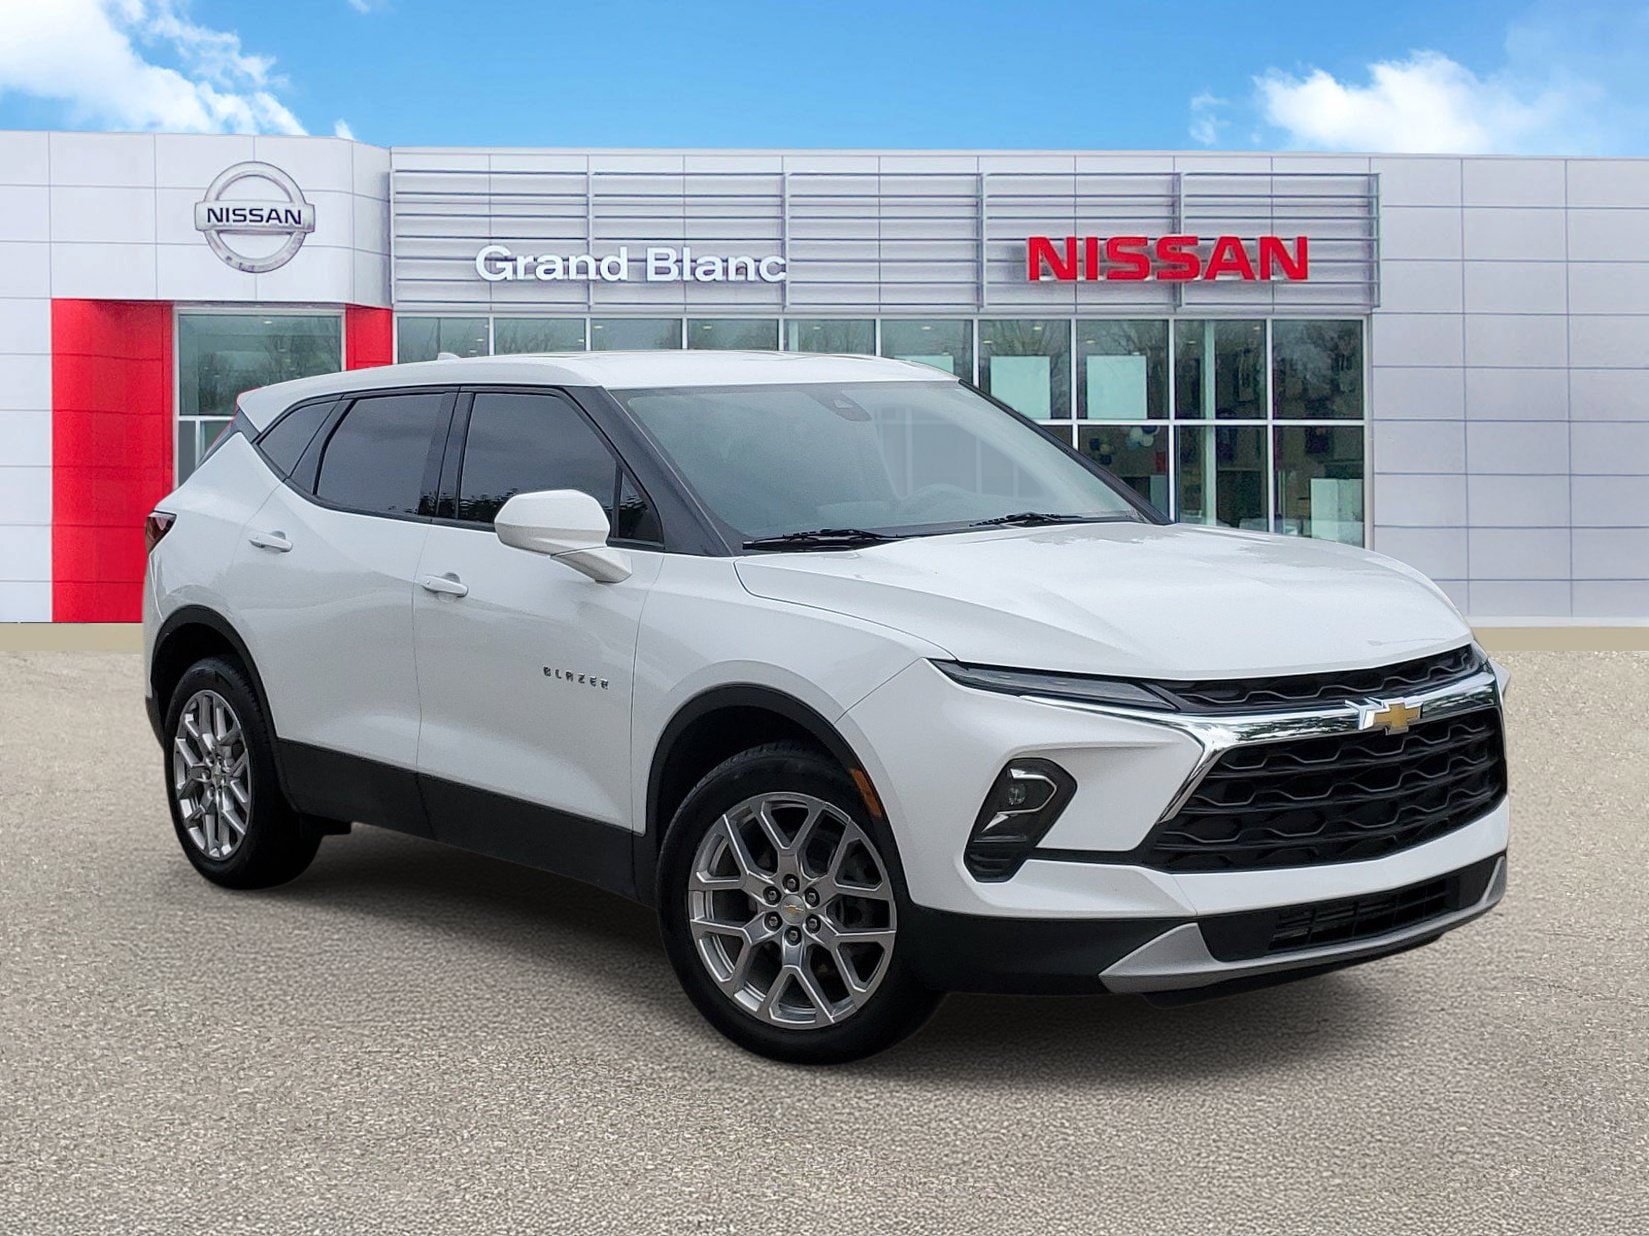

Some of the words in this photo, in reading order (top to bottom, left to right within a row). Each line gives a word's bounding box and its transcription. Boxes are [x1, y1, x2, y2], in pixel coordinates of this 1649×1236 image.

[207, 207, 302, 225] NISSAN
[475, 245, 628, 282] Grand
[646, 246, 787, 282] Blanc
[1027, 235, 1309, 282] NISSAN
[543, 666, 609, 690] BLAZER
